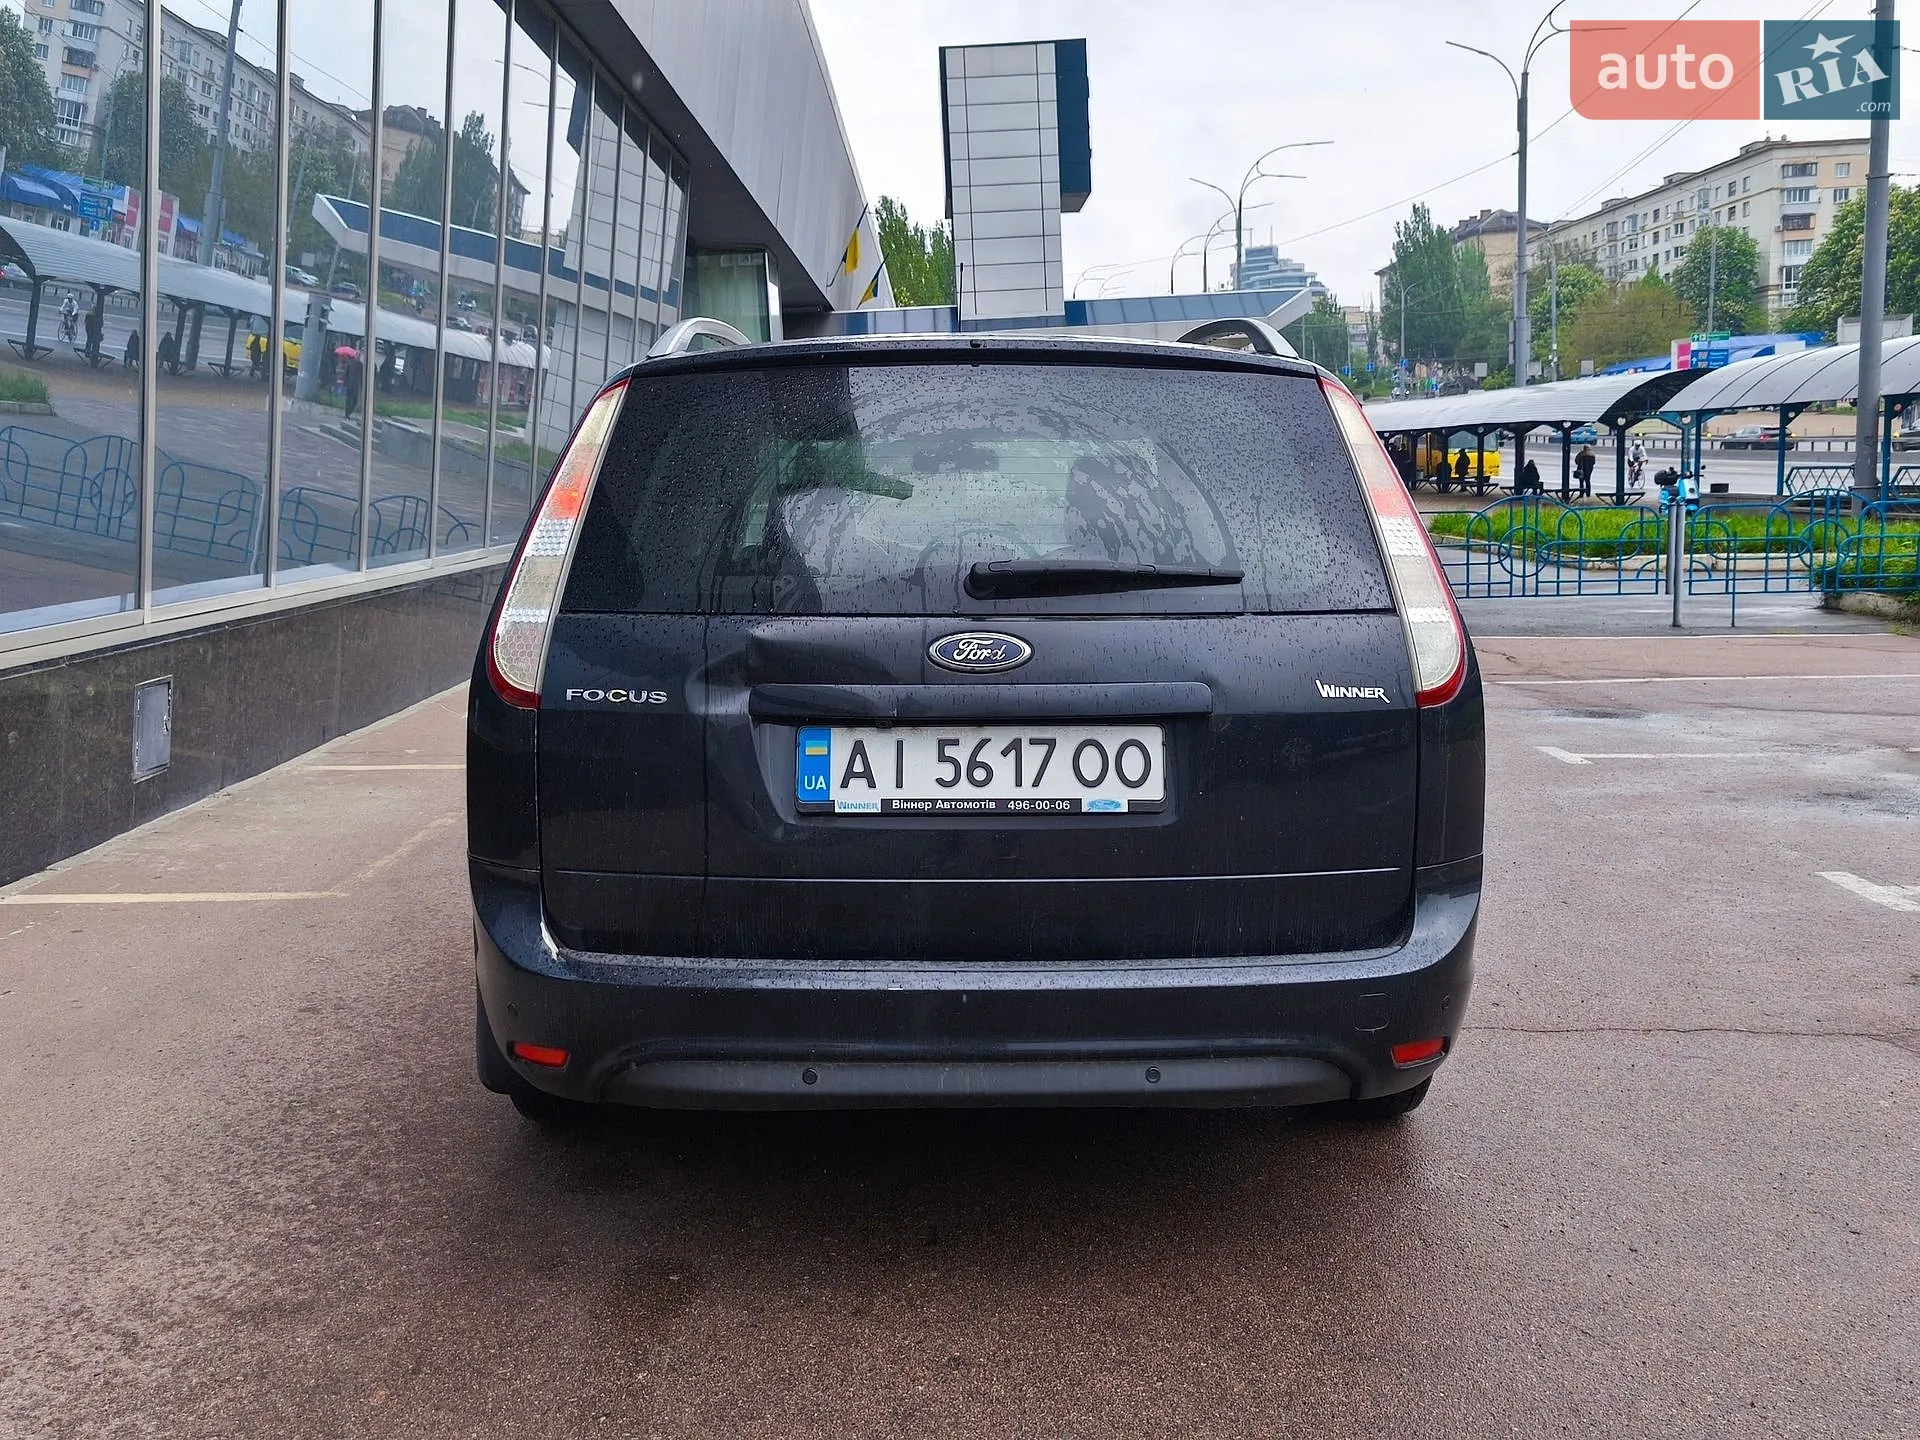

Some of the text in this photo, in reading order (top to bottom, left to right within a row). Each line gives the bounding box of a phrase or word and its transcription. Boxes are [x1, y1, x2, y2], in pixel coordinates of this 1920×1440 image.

[952, 638, 1007, 661] Ford
[566, 688, 668, 704] FOCUS
[1315, 679, 1391, 704] WINNER
[840, 739, 904, 789] AI
[935, 738, 1057, 788] 5617
[804, 775, 827, 790] UA
[892, 800, 996, 811] Віннер Автомотів
[1007, 800, 1071, 810] 496-00-06
